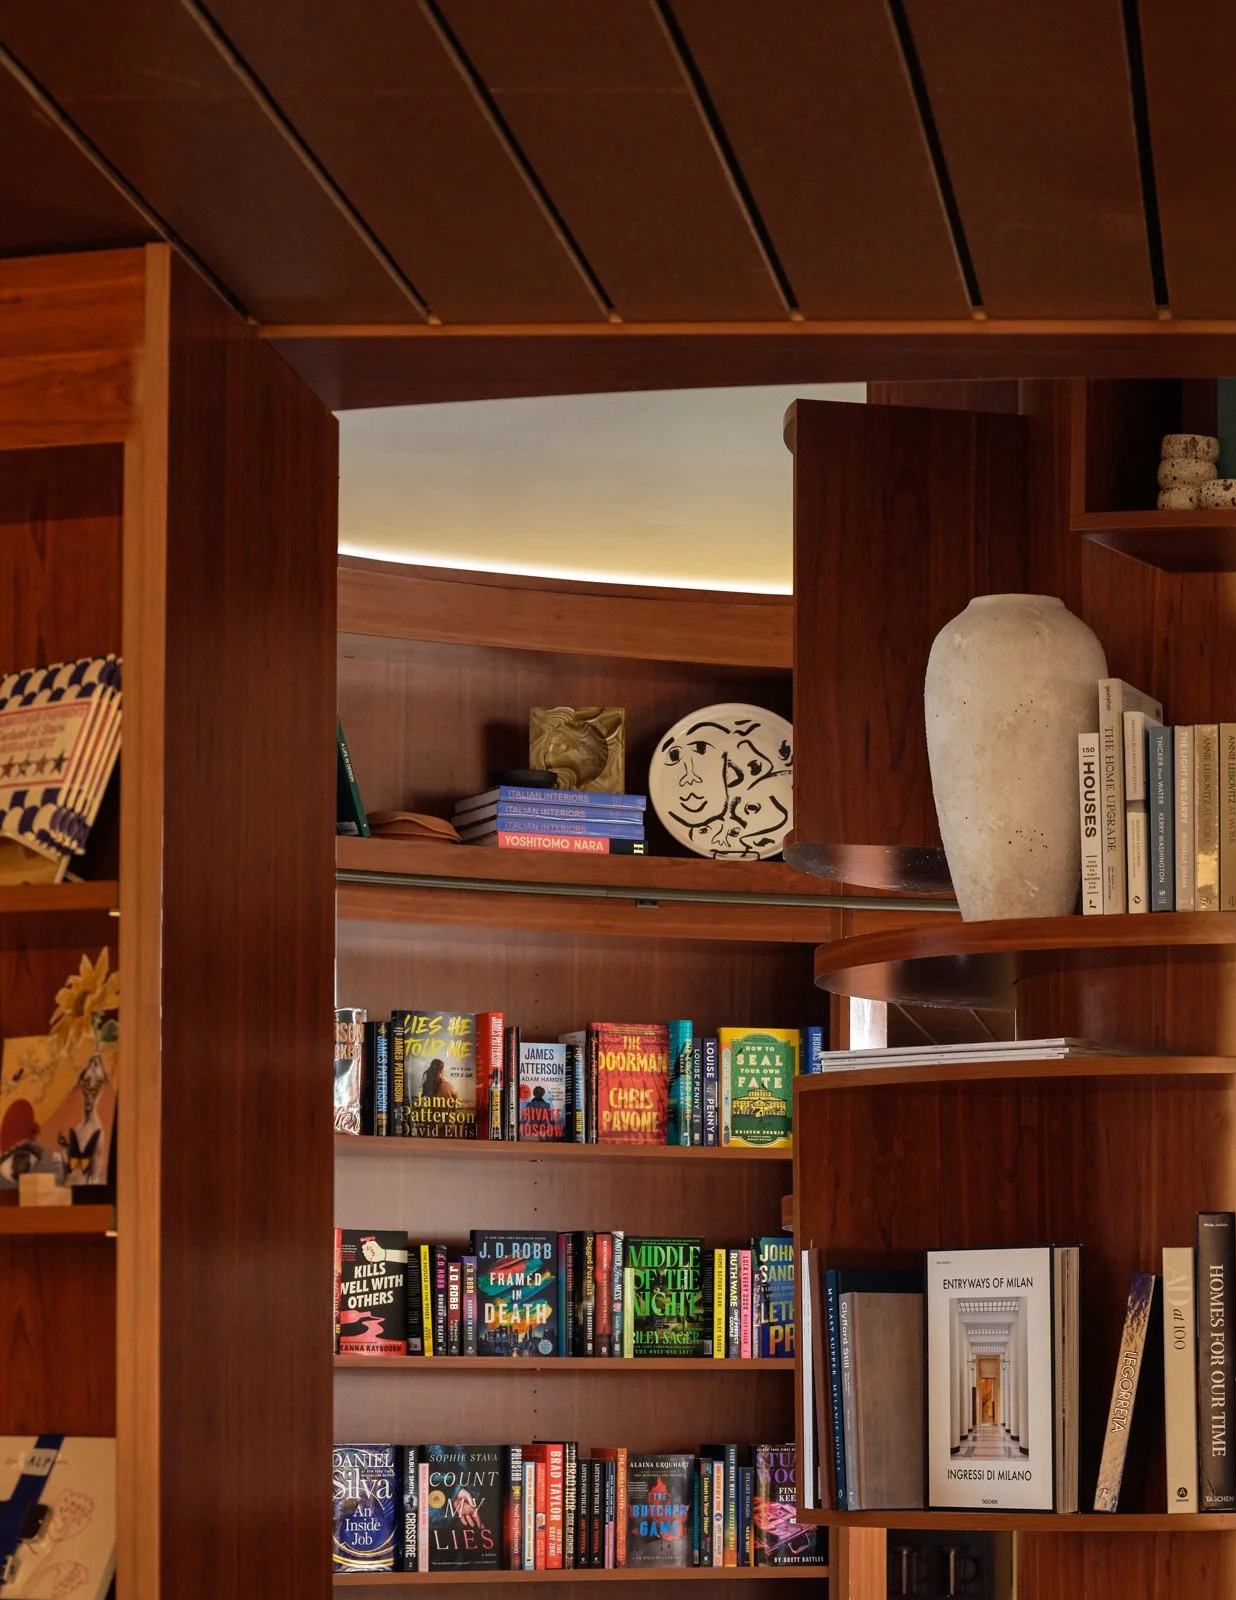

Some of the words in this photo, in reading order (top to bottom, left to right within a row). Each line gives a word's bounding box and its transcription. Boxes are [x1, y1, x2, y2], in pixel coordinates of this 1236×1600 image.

[1105, 727, 1114, 751] THE
[1105, 755, 1115, 790] HOME
[507, 789, 541, 802] ITALIAN
[543, 791, 591, 803] INTERIORS
[1083, 761, 1096, 838] HOUSES
[1107, 795, 1116, 852] UPGRADE
[504, 834, 570, 849] YOSHITOMO
[573, 837, 605, 852] NARA
[404, 1015, 442, 1034] LIES
[448, 1017, 472, 1036] HE
[447, 1040, 472, 1059] ME
[622, 1036, 641, 1050] THE
[525, 1049, 554, 1060] JAMES
[599, 1052, 667, 1072] DOORMAN
[706, 1042, 714, 1078] LOUISE
[737, 1055, 783, 1066] SEAL
[738, 1077, 783, 1088] FATE
[414, 1093, 463, 1108] James
[609, 1088, 653, 1109] CHRIS
[603, 1111, 659, 1132] PAVONE
[706, 1099, 714, 1134] PENNY
[479, 1243, 491, 1258] J.
[496, 1243, 508, 1258] D.
[512, 1243, 552, 1258] ROBB
[629, 1246, 700, 1267] MIDDLE
[354, 1263, 386, 1278] KILLS
[490, 1273, 541, 1286] FRAMED
[665, 1269, 700, 1290] THE
[378, 1274, 403, 1290] WITH
[943, 1277, 991, 1289] ENTRYWAYS
[993, 1277, 1004, 1288] OF
[1006, 1276, 1033, 1288] MILAN
[348, 1291, 393, 1309] OTHERS
[512, 1290, 522, 1300] IN
[1209, 1264, 1224, 1327] HOMES
[485, 1303, 547, 1324] DEATH
[1210, 1330, 1224, 1364] FOR
[1112, 1351, 1138, 1433] LEGORRETA
[1211, 1367, 1225, 1407] OUR
[1212, 1411, 1226, 1457] TIME
[333, 1453, 394, 1468] DANIEL
[430, 1454, 467, 1462] SOPHIE
[333, 1469, 392, 1499] Silva
[430, 1472, 498, 1486] COUNT
[947, 1469, 985, 1481] INGRESSI
[986, 1470, 996, 1481] DI
[997, 1469, 1032, 1482] MILANO
[653, 1493, 667, 1501] THE
[355, 1505, 371, 1516] An
[445, 1498, 484, 1517] MY
[633, 1504, 687, 1517] BUTCHER
[345, 1519, 381, 1532] Inside
[640, 1522, 679, 1536] GAME
[352, 1533, 372, 1545] Job
[406, 1513, 415, 1558] CROSSFIRE
[434, 1530, 494, 1549] LIES
